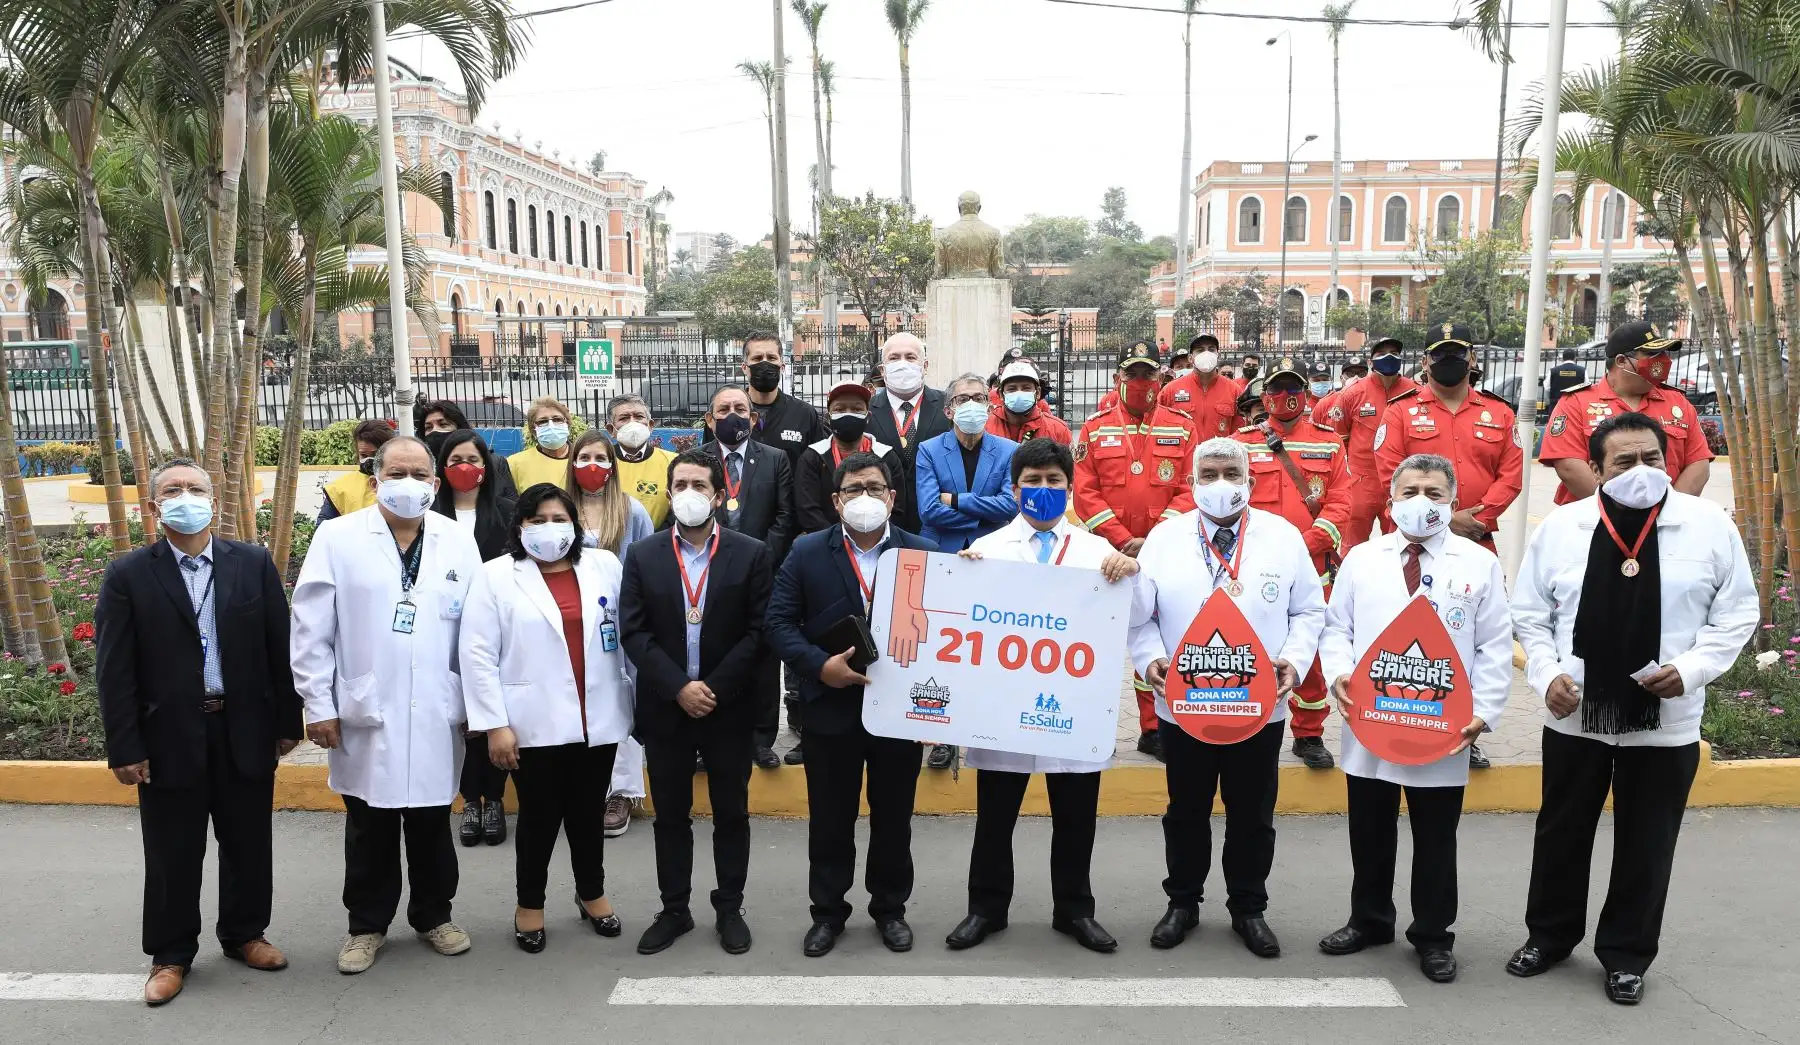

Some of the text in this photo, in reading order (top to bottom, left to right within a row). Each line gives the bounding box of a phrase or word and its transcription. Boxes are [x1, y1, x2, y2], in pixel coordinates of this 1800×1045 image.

[780, 433, 802, 442] WARS
[972, 604, 1068, 631] Donante
[936, 627, 1095, 678] 21 000
[1184, 643, 1251, 655] HINCHAS DE
[1178, 654, 1256, 674] SANGRE
[1379, 650, 1451, 669] HINCHAS DE
[1370, 660, 1454, 690] SANGRE
[914, 682, 938, 690] HINCHAS
[910, 688, 950, 702] SANGRE
[1190, 692, 1219, 700] DONA
[1210, 705, 1257, 713] SIEMPRE
[1381, 701, 1410, 710] DONA
[1020, 712, 1073, 729] EsSalud
[1364, 711, 1448, 730] DONA SIEMPRE
